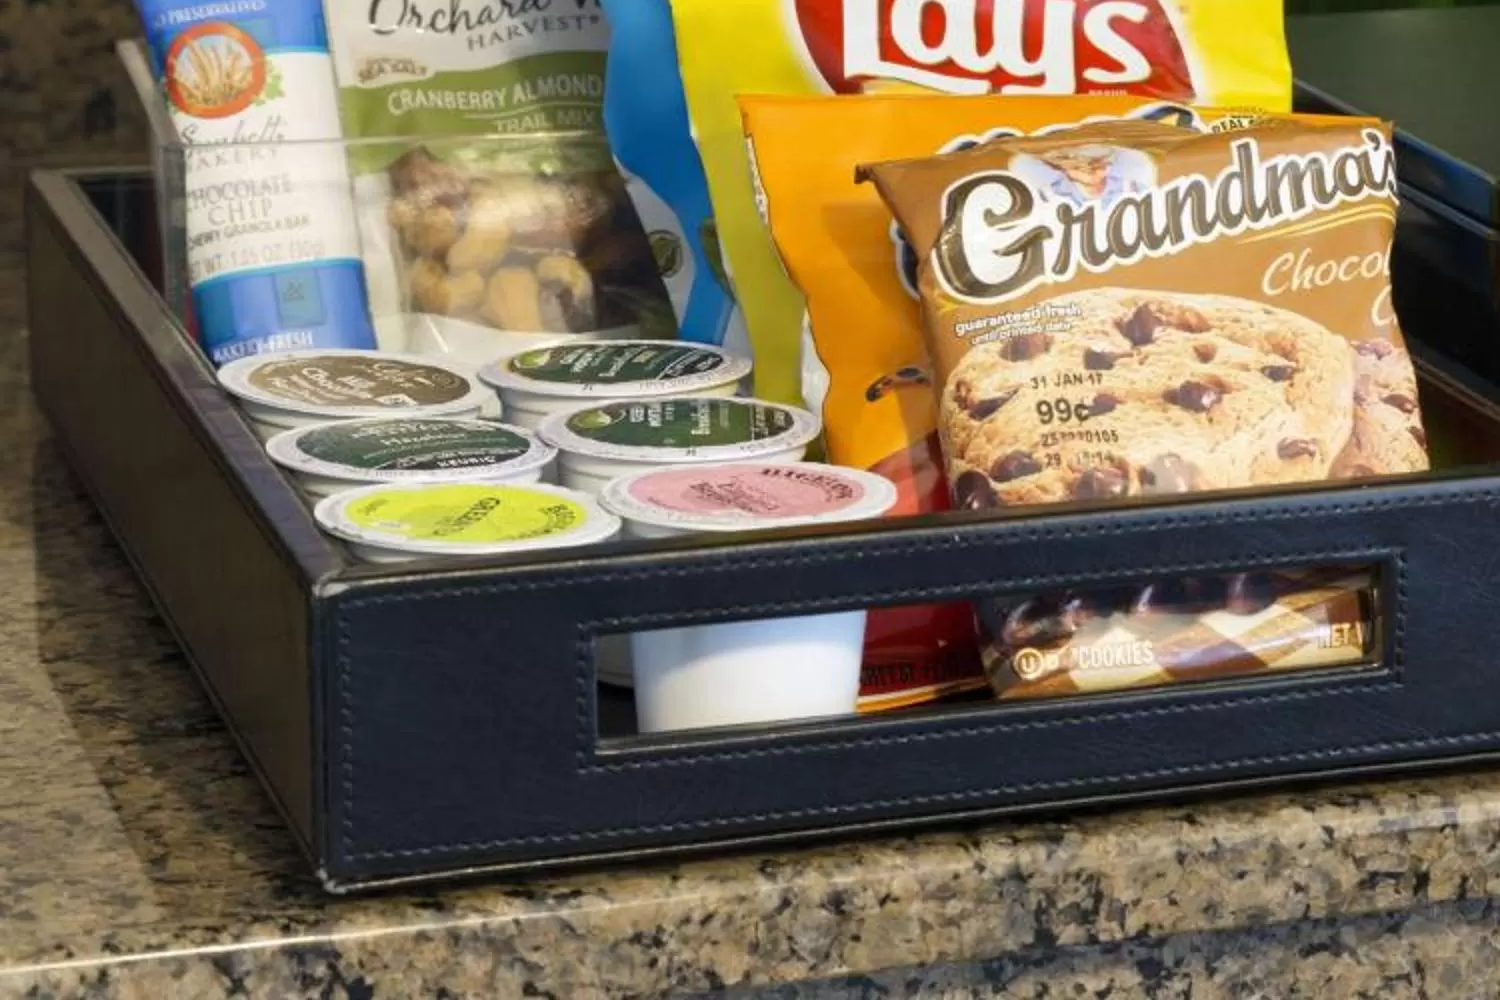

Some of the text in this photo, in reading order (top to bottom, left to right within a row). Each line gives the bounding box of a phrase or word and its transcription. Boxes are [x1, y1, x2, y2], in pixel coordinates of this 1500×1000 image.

[467, 13, 590, 51] HARVEST
[387, 73, 603, 116] CRANBERRY ALMOND
[494, 109, 597, 135] TRAIL MIX
[937, 129, 1397, 298] Grandma's
[1054, 373, 1083, 388] JAN
[1078, 640, 1153, 669] COOKIES
